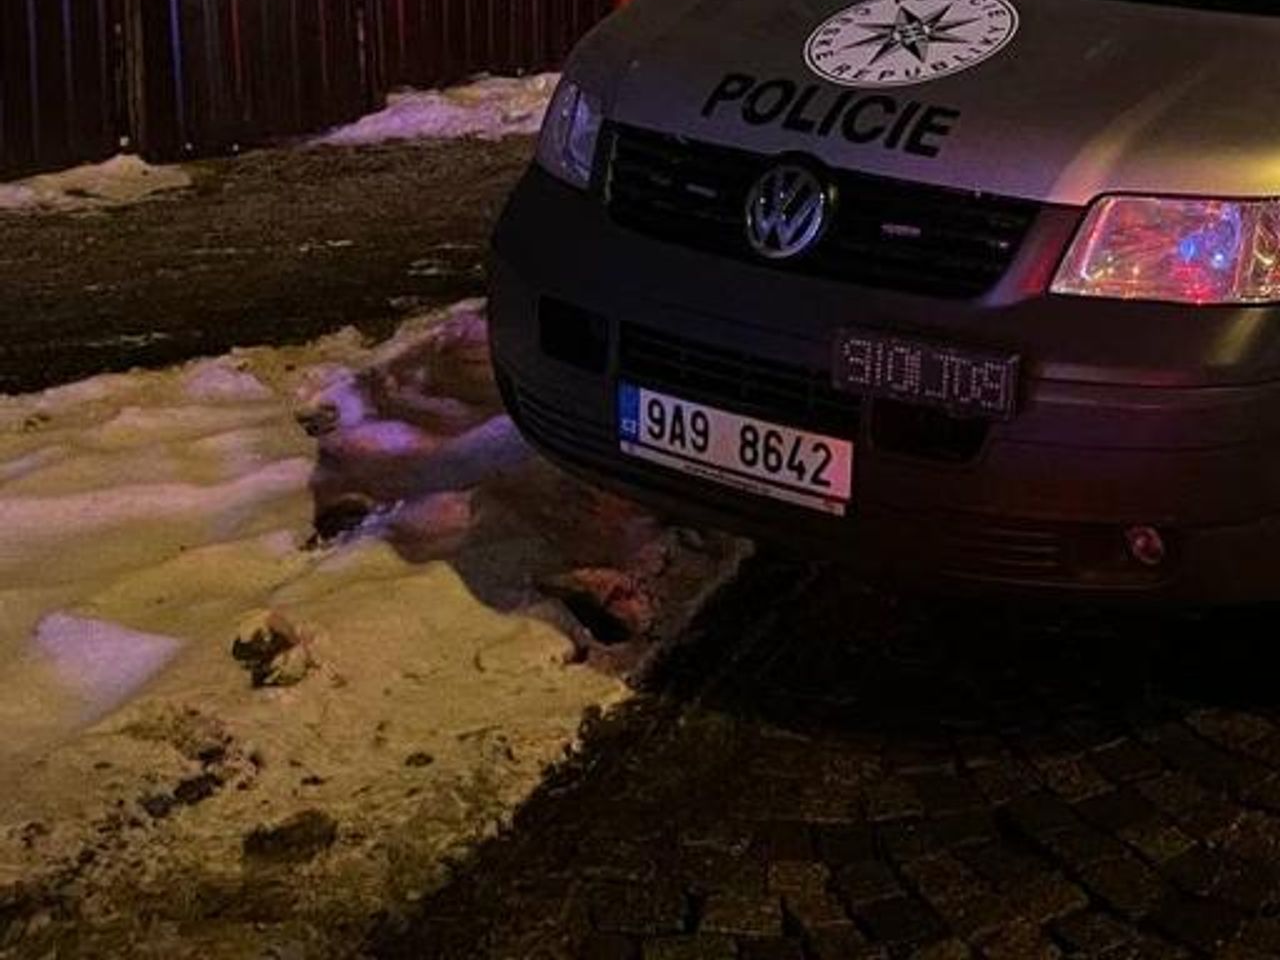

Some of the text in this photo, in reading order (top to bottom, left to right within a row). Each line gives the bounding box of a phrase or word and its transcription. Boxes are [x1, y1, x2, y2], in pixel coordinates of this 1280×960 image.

[701, 73, 960, 159] POLICIE
[647, 398, 709, 453] 9A9
[739, 424, 832, 487] 8642
